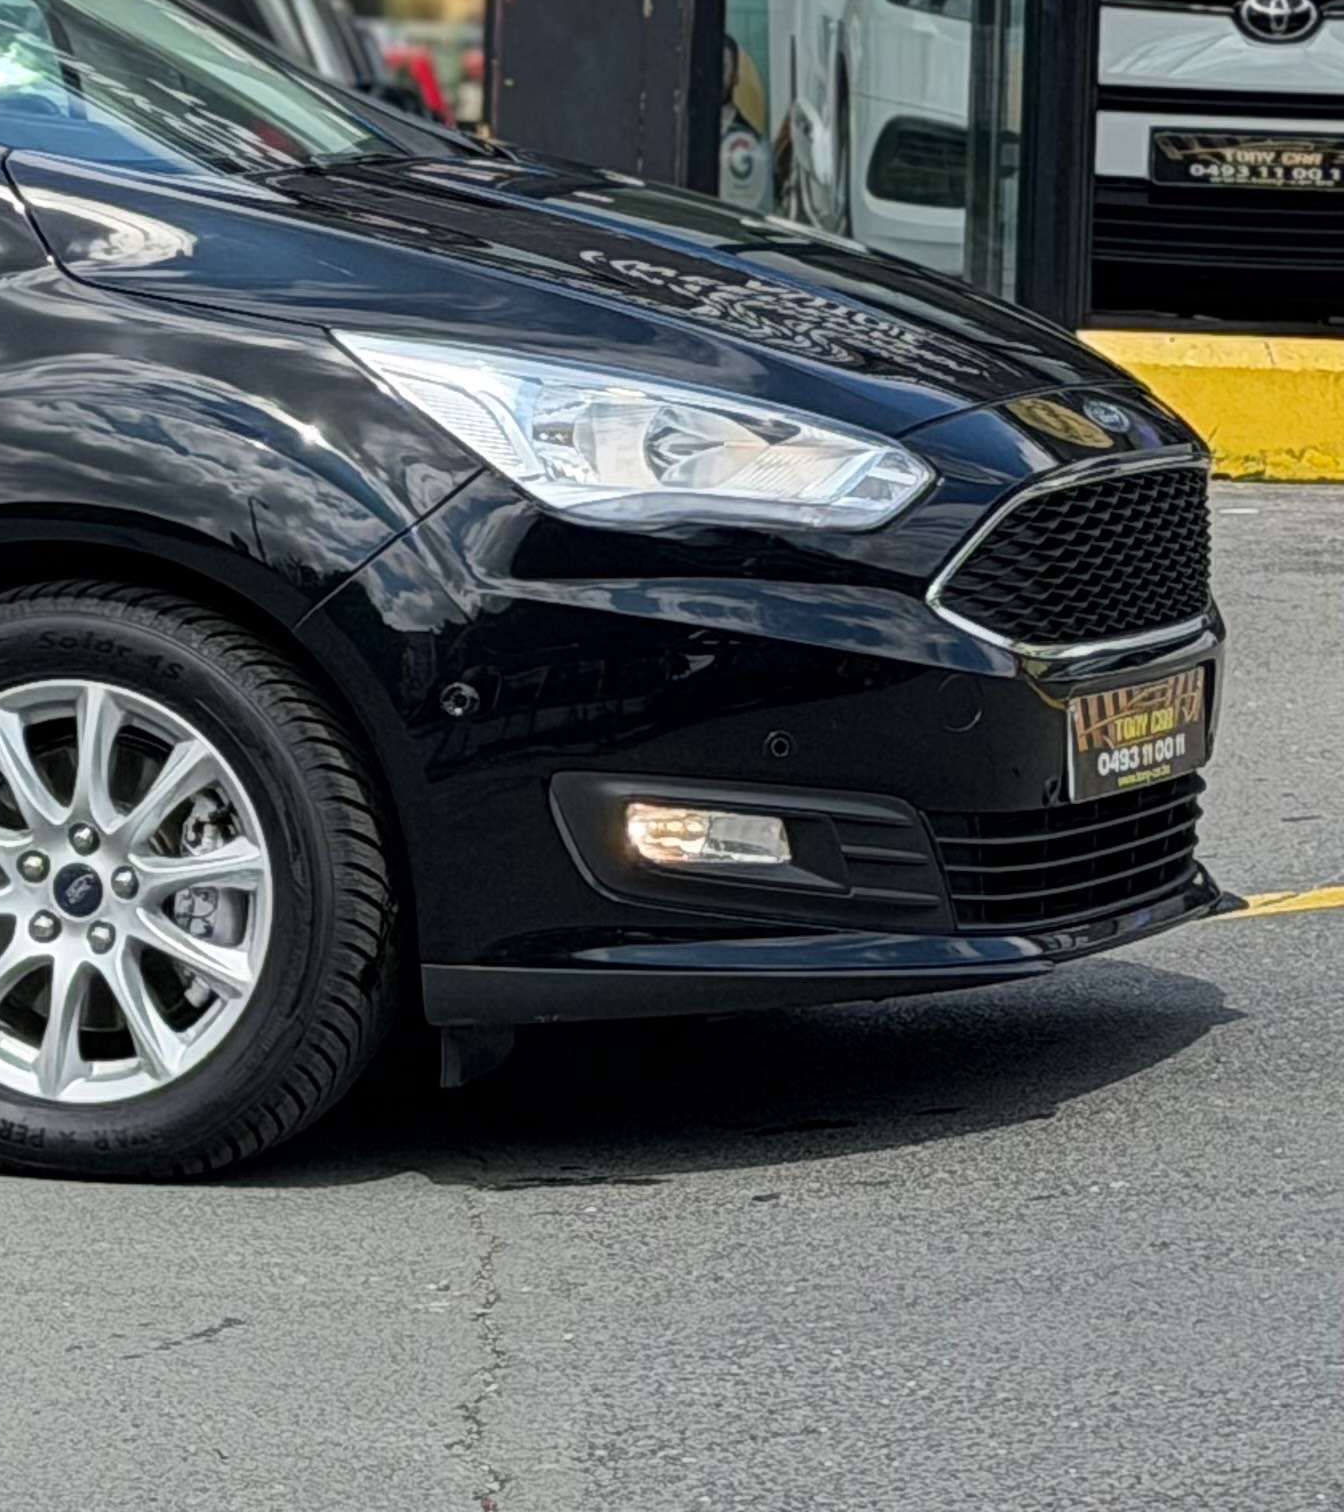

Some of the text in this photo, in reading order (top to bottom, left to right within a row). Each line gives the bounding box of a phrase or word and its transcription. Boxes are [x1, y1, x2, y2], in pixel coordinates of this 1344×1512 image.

[1097, 732, 1186, 777] 0493 11 00 11
